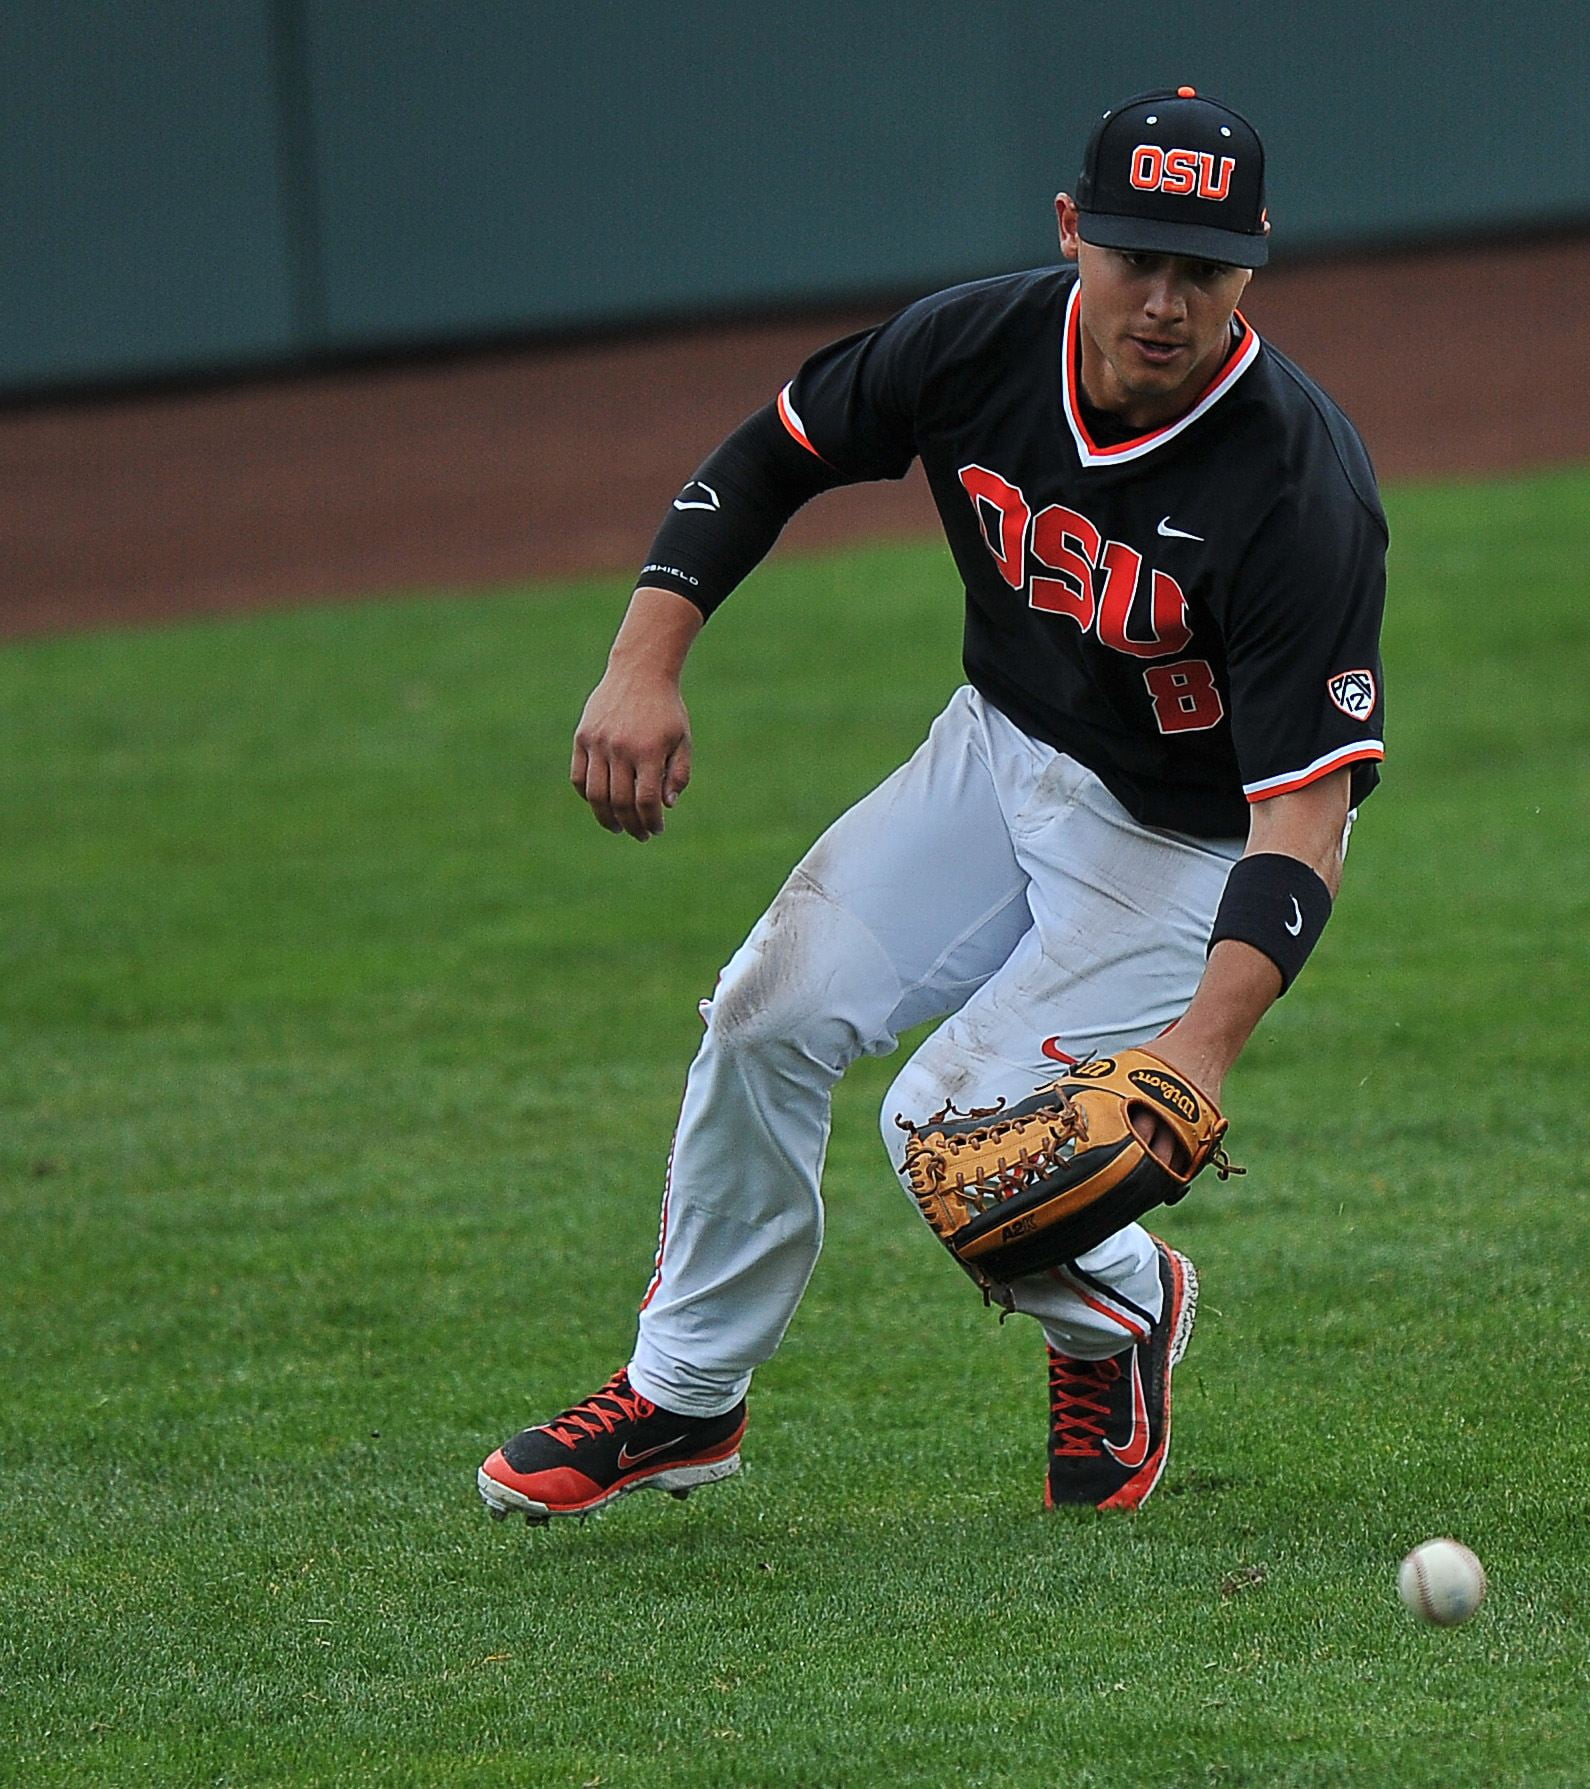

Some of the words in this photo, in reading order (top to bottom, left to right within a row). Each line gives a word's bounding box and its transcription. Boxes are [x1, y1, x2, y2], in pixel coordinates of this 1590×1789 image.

[1130, 145, 1235, 201] OSU
[642, 564, 699, 586] SHIELD
[958, 464, 1193, 658] OSU
[1143, 660, 1224, 734] 8
[1331, 673, 1372, 706] PAC
[1346, 693, 1368, 712] 12
[1136, 1071, 1196, 1120] Wilson
[1002, 1213, 1038, 1242] A2K
